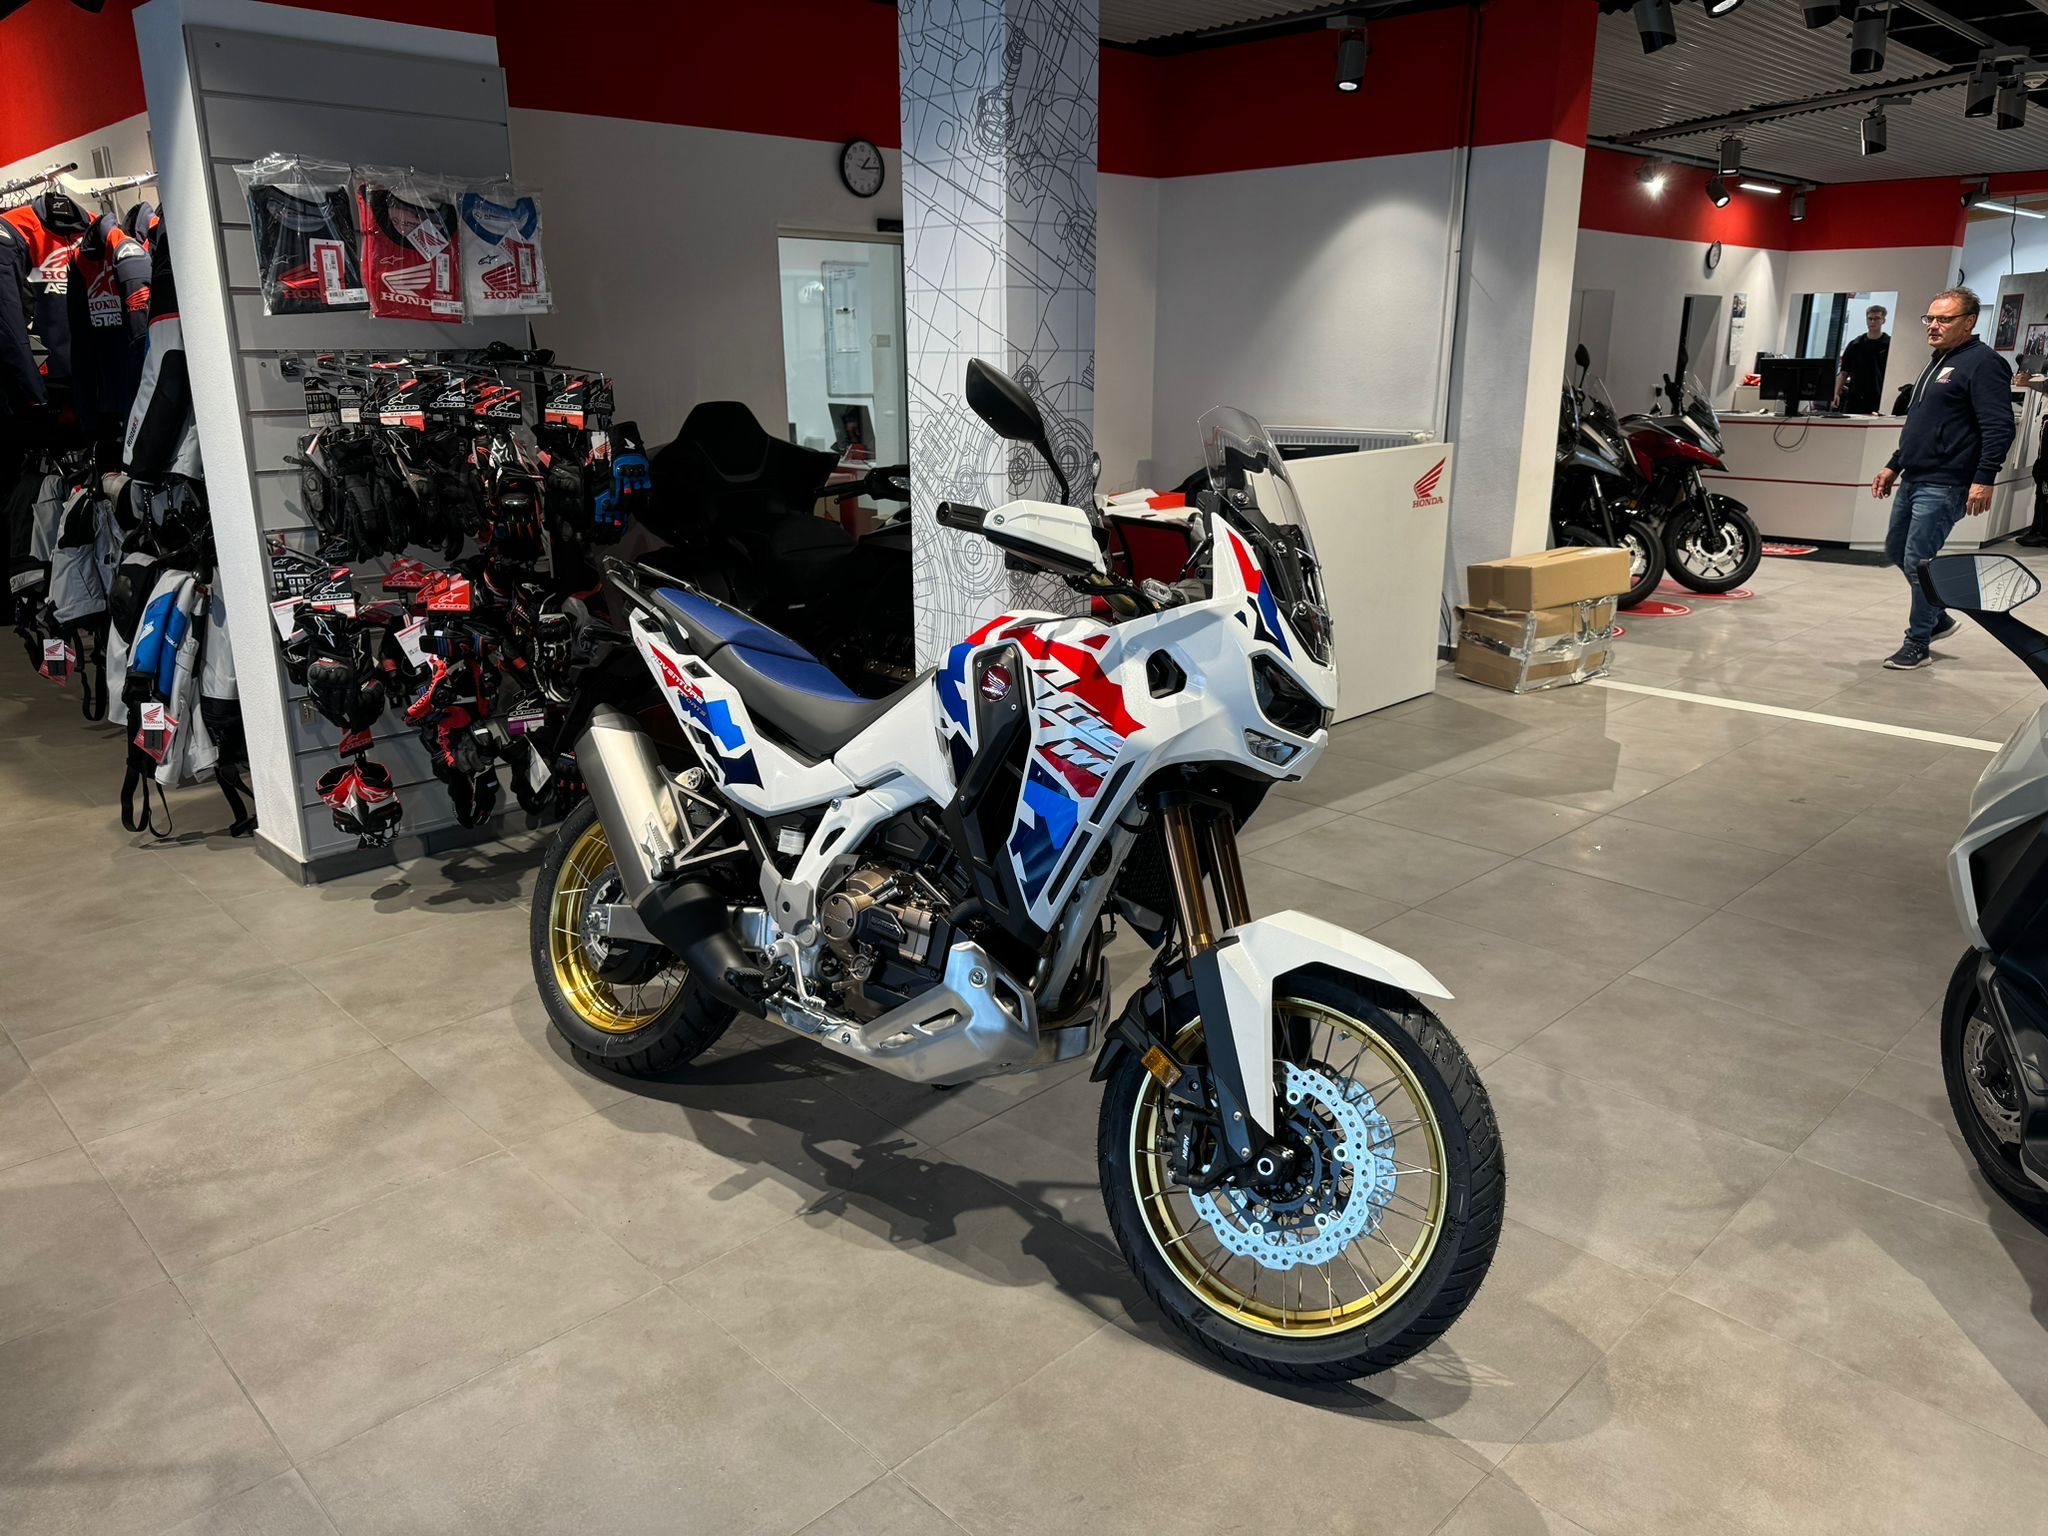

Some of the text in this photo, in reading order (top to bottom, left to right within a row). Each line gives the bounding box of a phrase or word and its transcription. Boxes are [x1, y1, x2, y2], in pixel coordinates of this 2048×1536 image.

[381, 291, 431, 306] HOND
[483, 291, 520, 299] HON
[1412, 496, 1444, 508] HONDA
[651, 655, 704, 704] ADVENTURE
